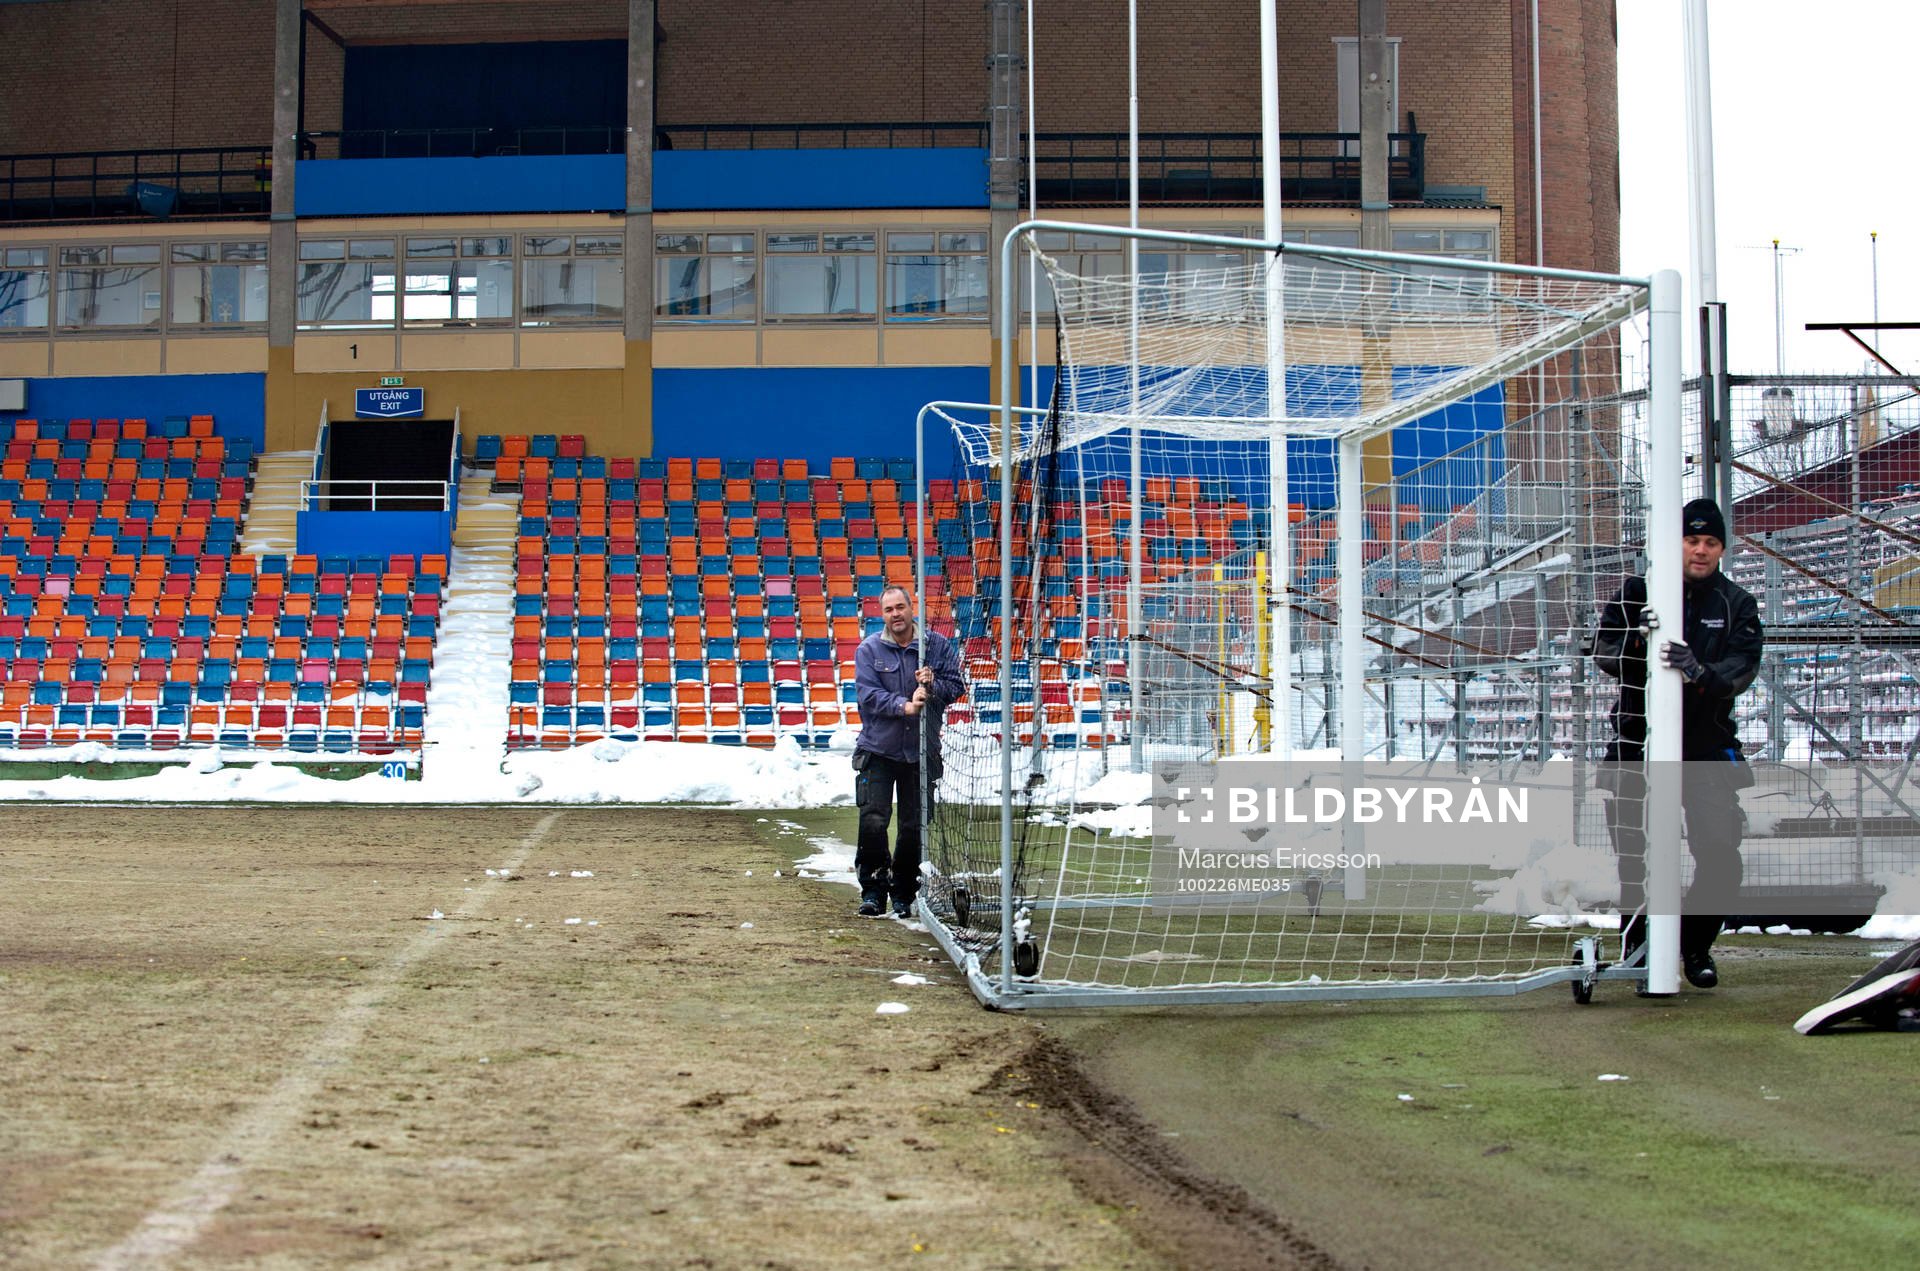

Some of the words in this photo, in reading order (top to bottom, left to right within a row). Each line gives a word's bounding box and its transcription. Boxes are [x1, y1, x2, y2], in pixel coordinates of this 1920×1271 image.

[349, 344, 357, 359] 1
[369, 390, 410, 401] UTGÅNG
[380, 402, 401, 410] EXIT
[384, 763, 406, 779] 30
